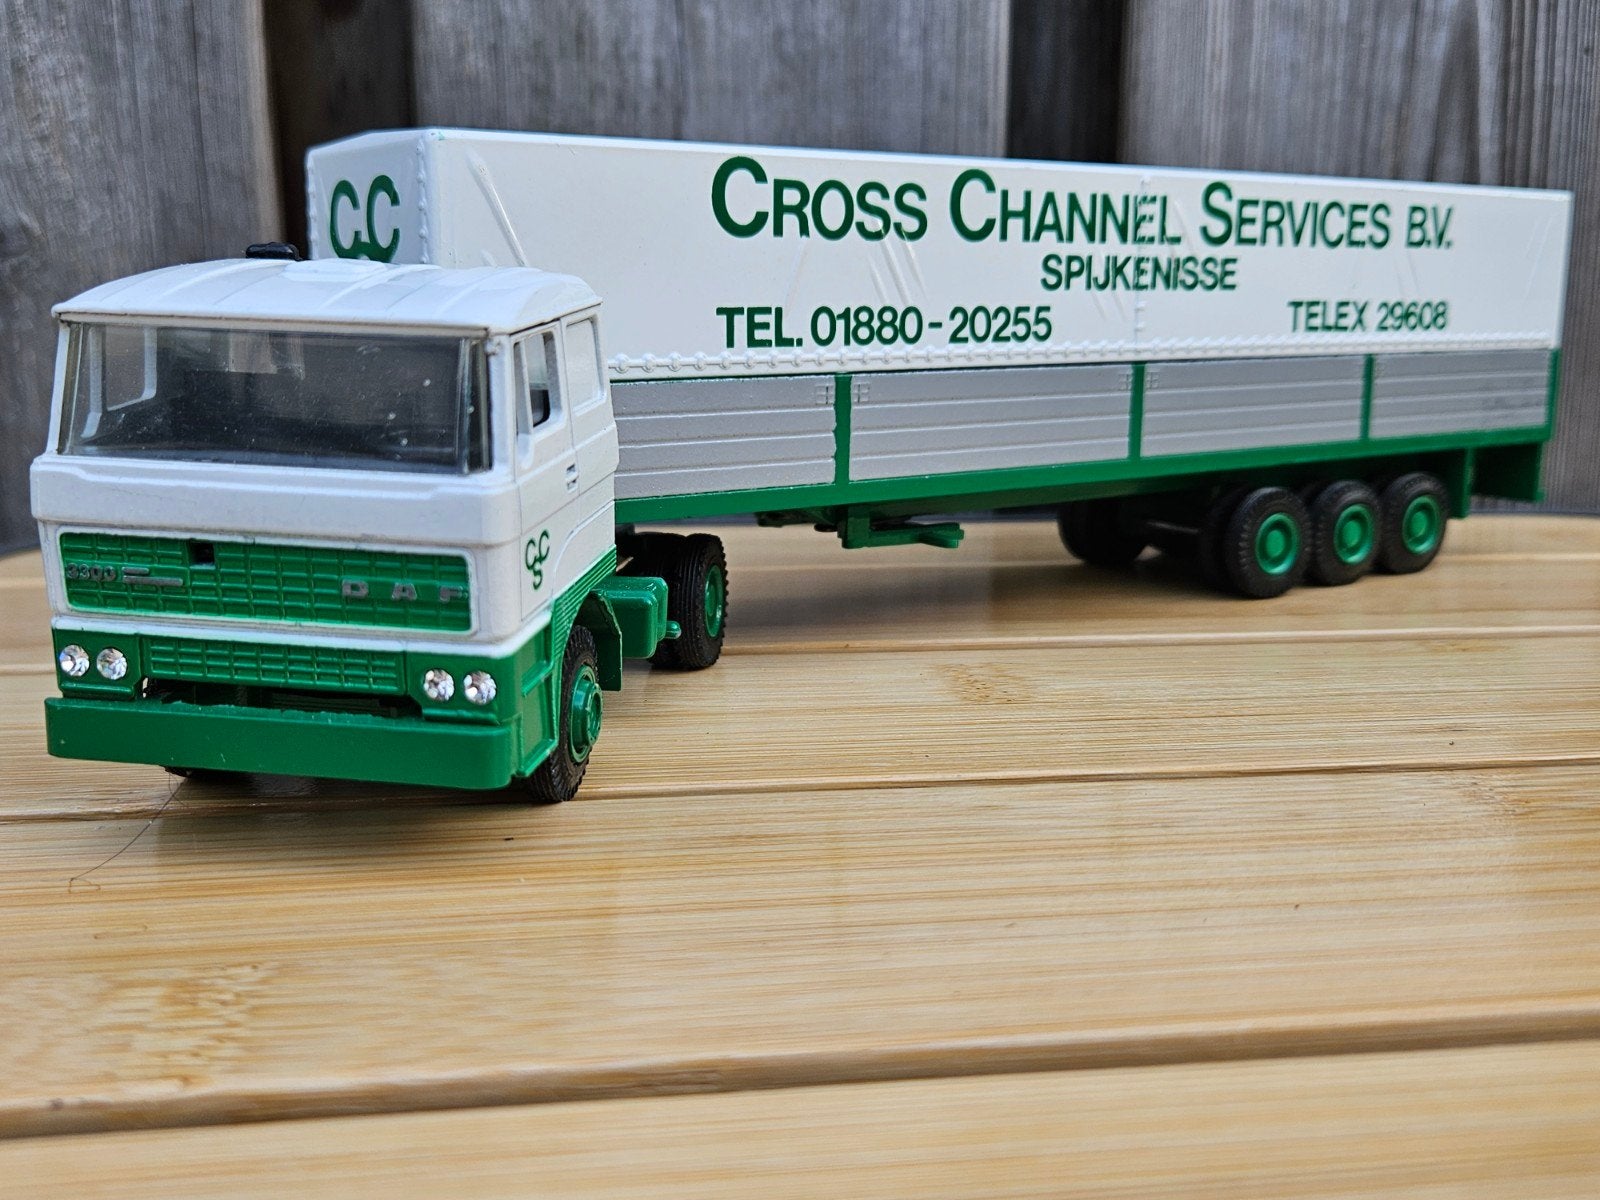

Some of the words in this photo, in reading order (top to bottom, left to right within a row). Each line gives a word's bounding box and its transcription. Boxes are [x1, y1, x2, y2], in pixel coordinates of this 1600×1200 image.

[711, 156, 928, 242] CROSS
[949, 168, 1182, 246] CHANNEL
[1199, 181, 1390, 249] SERVICES
[1405, 206, 1453, 249] B.V.
[1041, 253, 1239, 291] SPIJKENISSE
[1287, 300, 1369, 332] TELEX
[1376, 301, 1448, 332] 29608
[341, 579, 468, 602] DAF
